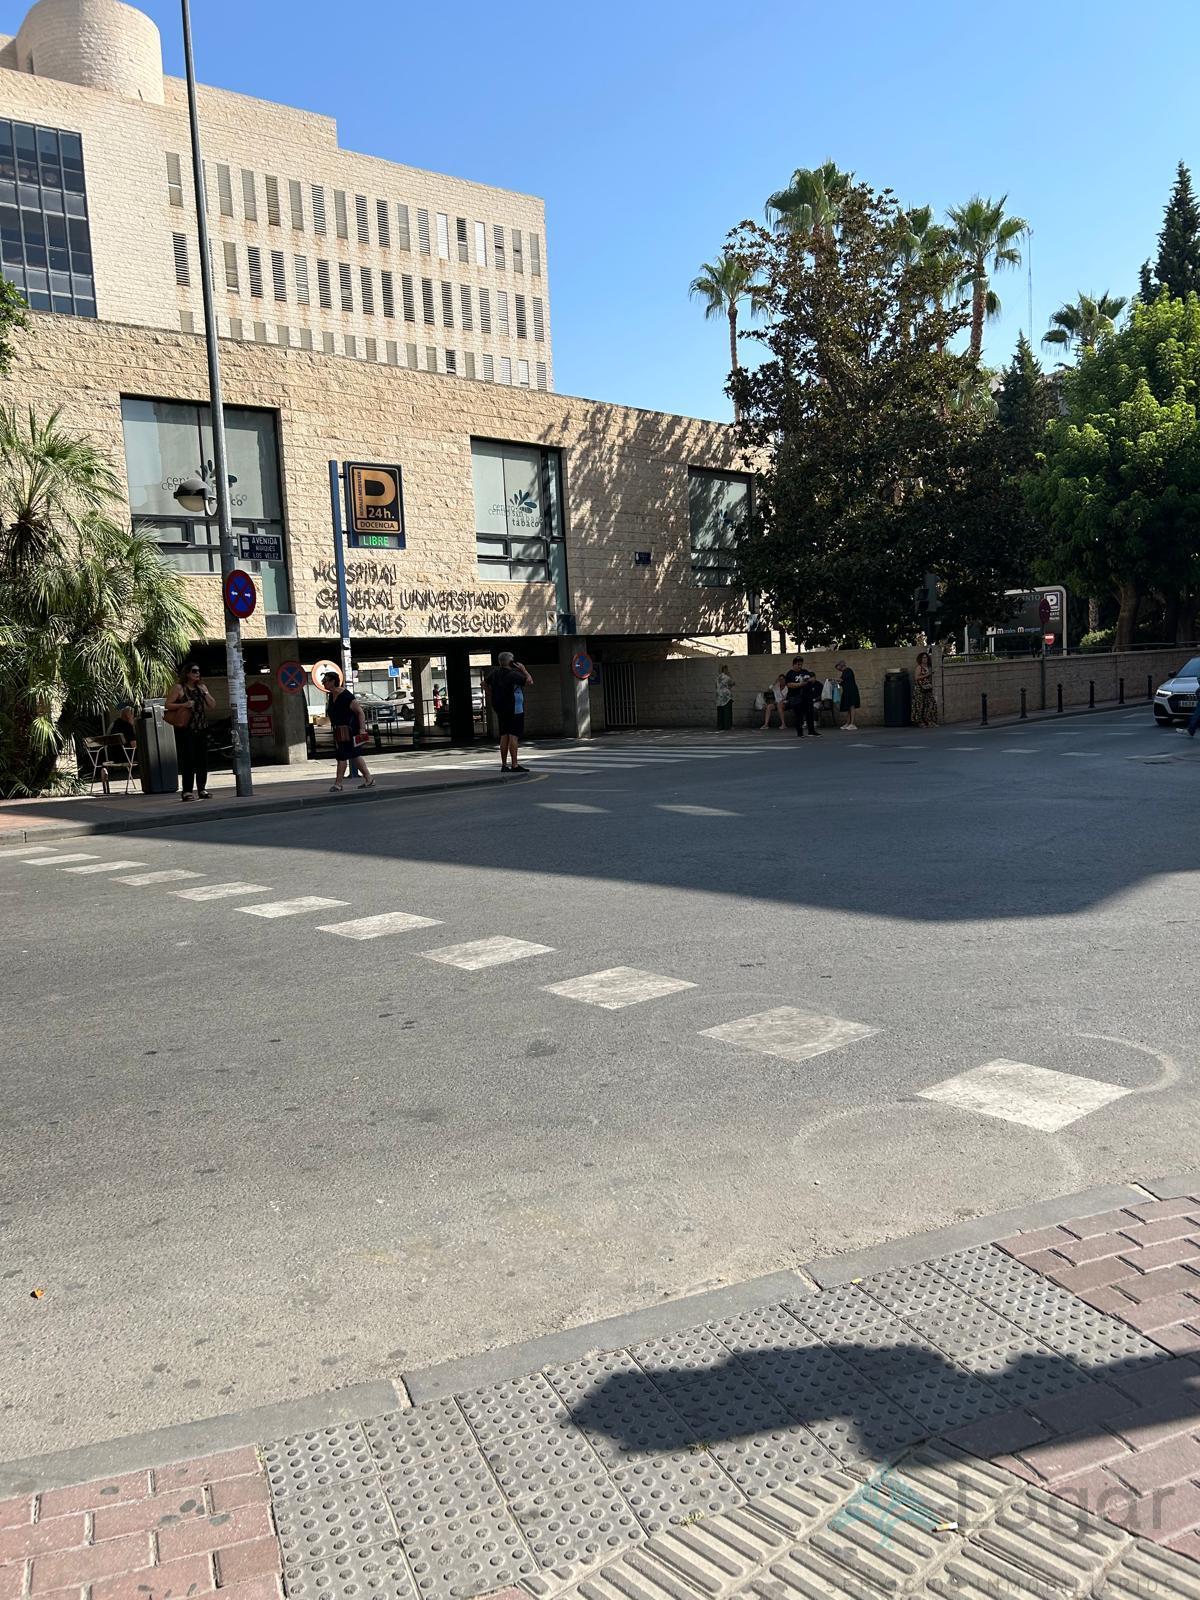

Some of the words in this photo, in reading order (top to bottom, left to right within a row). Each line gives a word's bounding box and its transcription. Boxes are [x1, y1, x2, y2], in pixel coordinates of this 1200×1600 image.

[353, 468, 397, 519] P
[360, 521, 395, 529] DOCENCIA
[252, 536, 278, 545] AVENIDA
[363, 535, 390, 546] LIBRE
[400, 588, 510, 612] UNIVERSITARIO
[428, 612, 512, 635] MESEGUER
